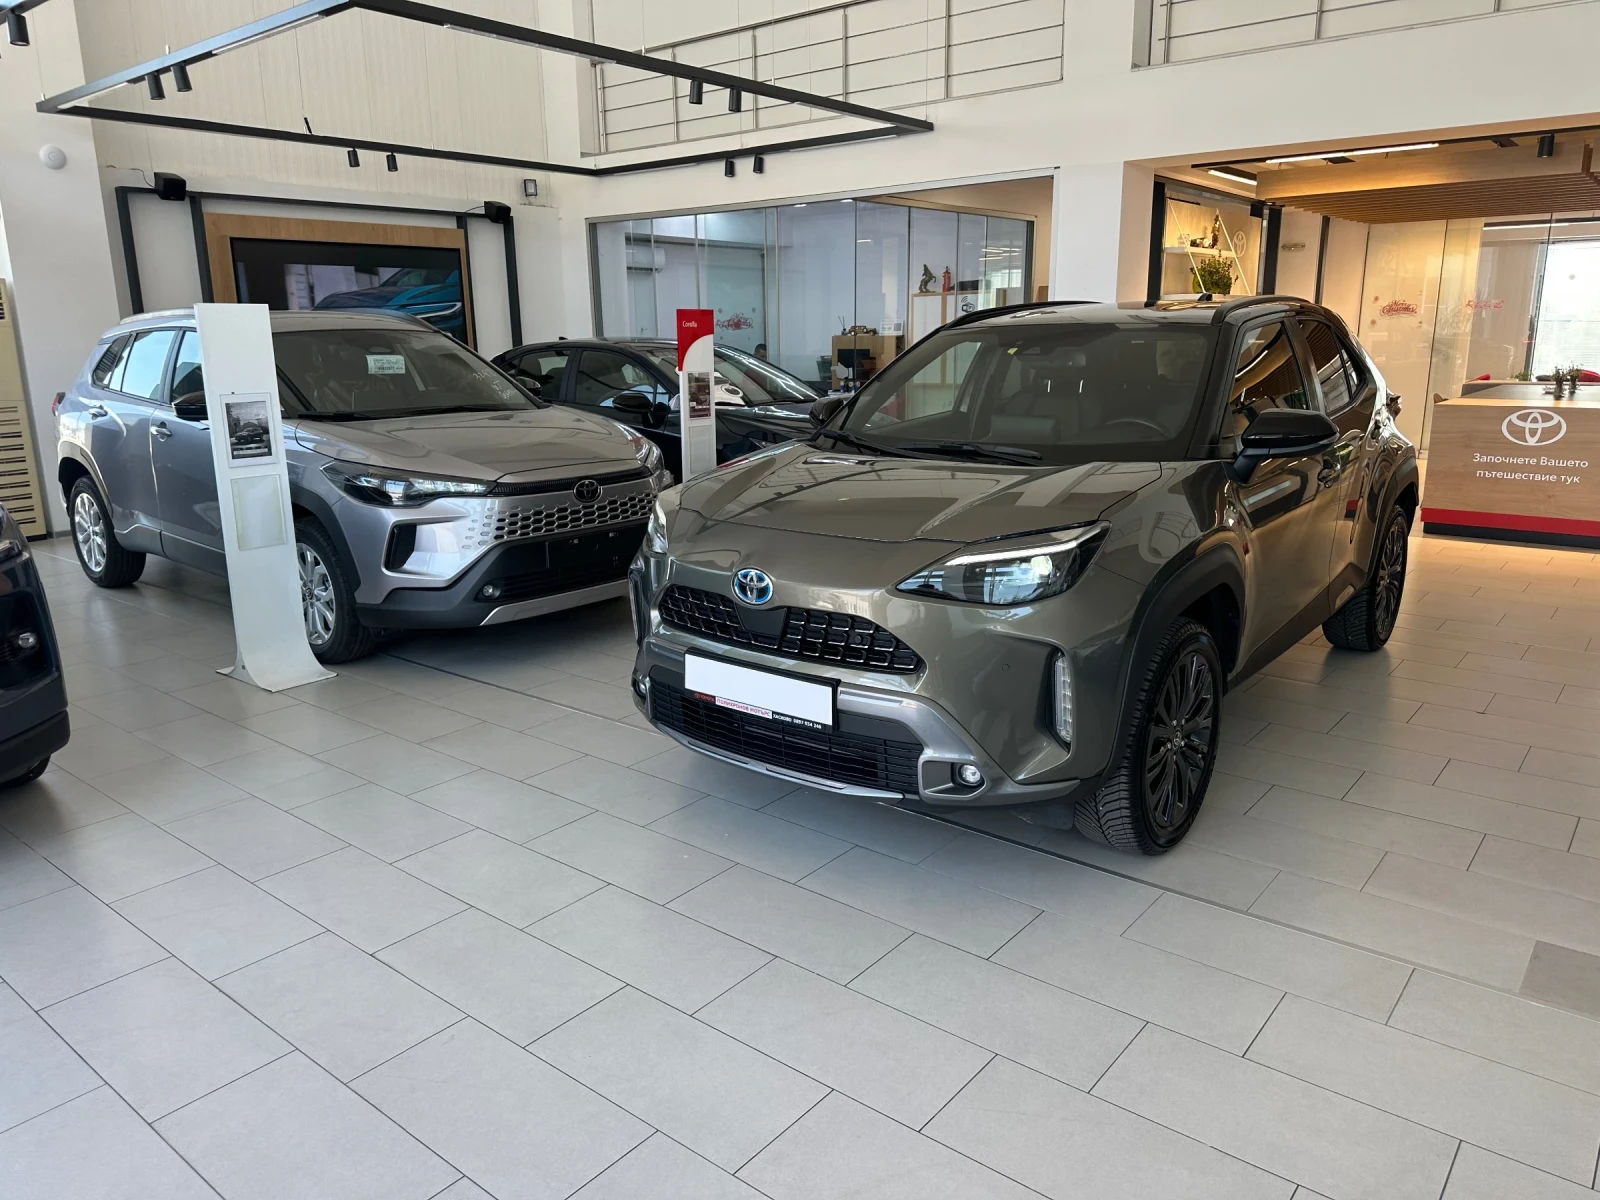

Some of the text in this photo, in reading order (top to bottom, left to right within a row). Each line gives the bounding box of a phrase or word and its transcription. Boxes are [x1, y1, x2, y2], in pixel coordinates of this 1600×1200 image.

[682, 320, 698, 328] Corolla
[1473, 453, 1589, 468] Започнете Вашето
[1476, 469, 1581, 485] пътешествие тук
[717, 698, 749, 711] ПОЛИХРОНОВ
